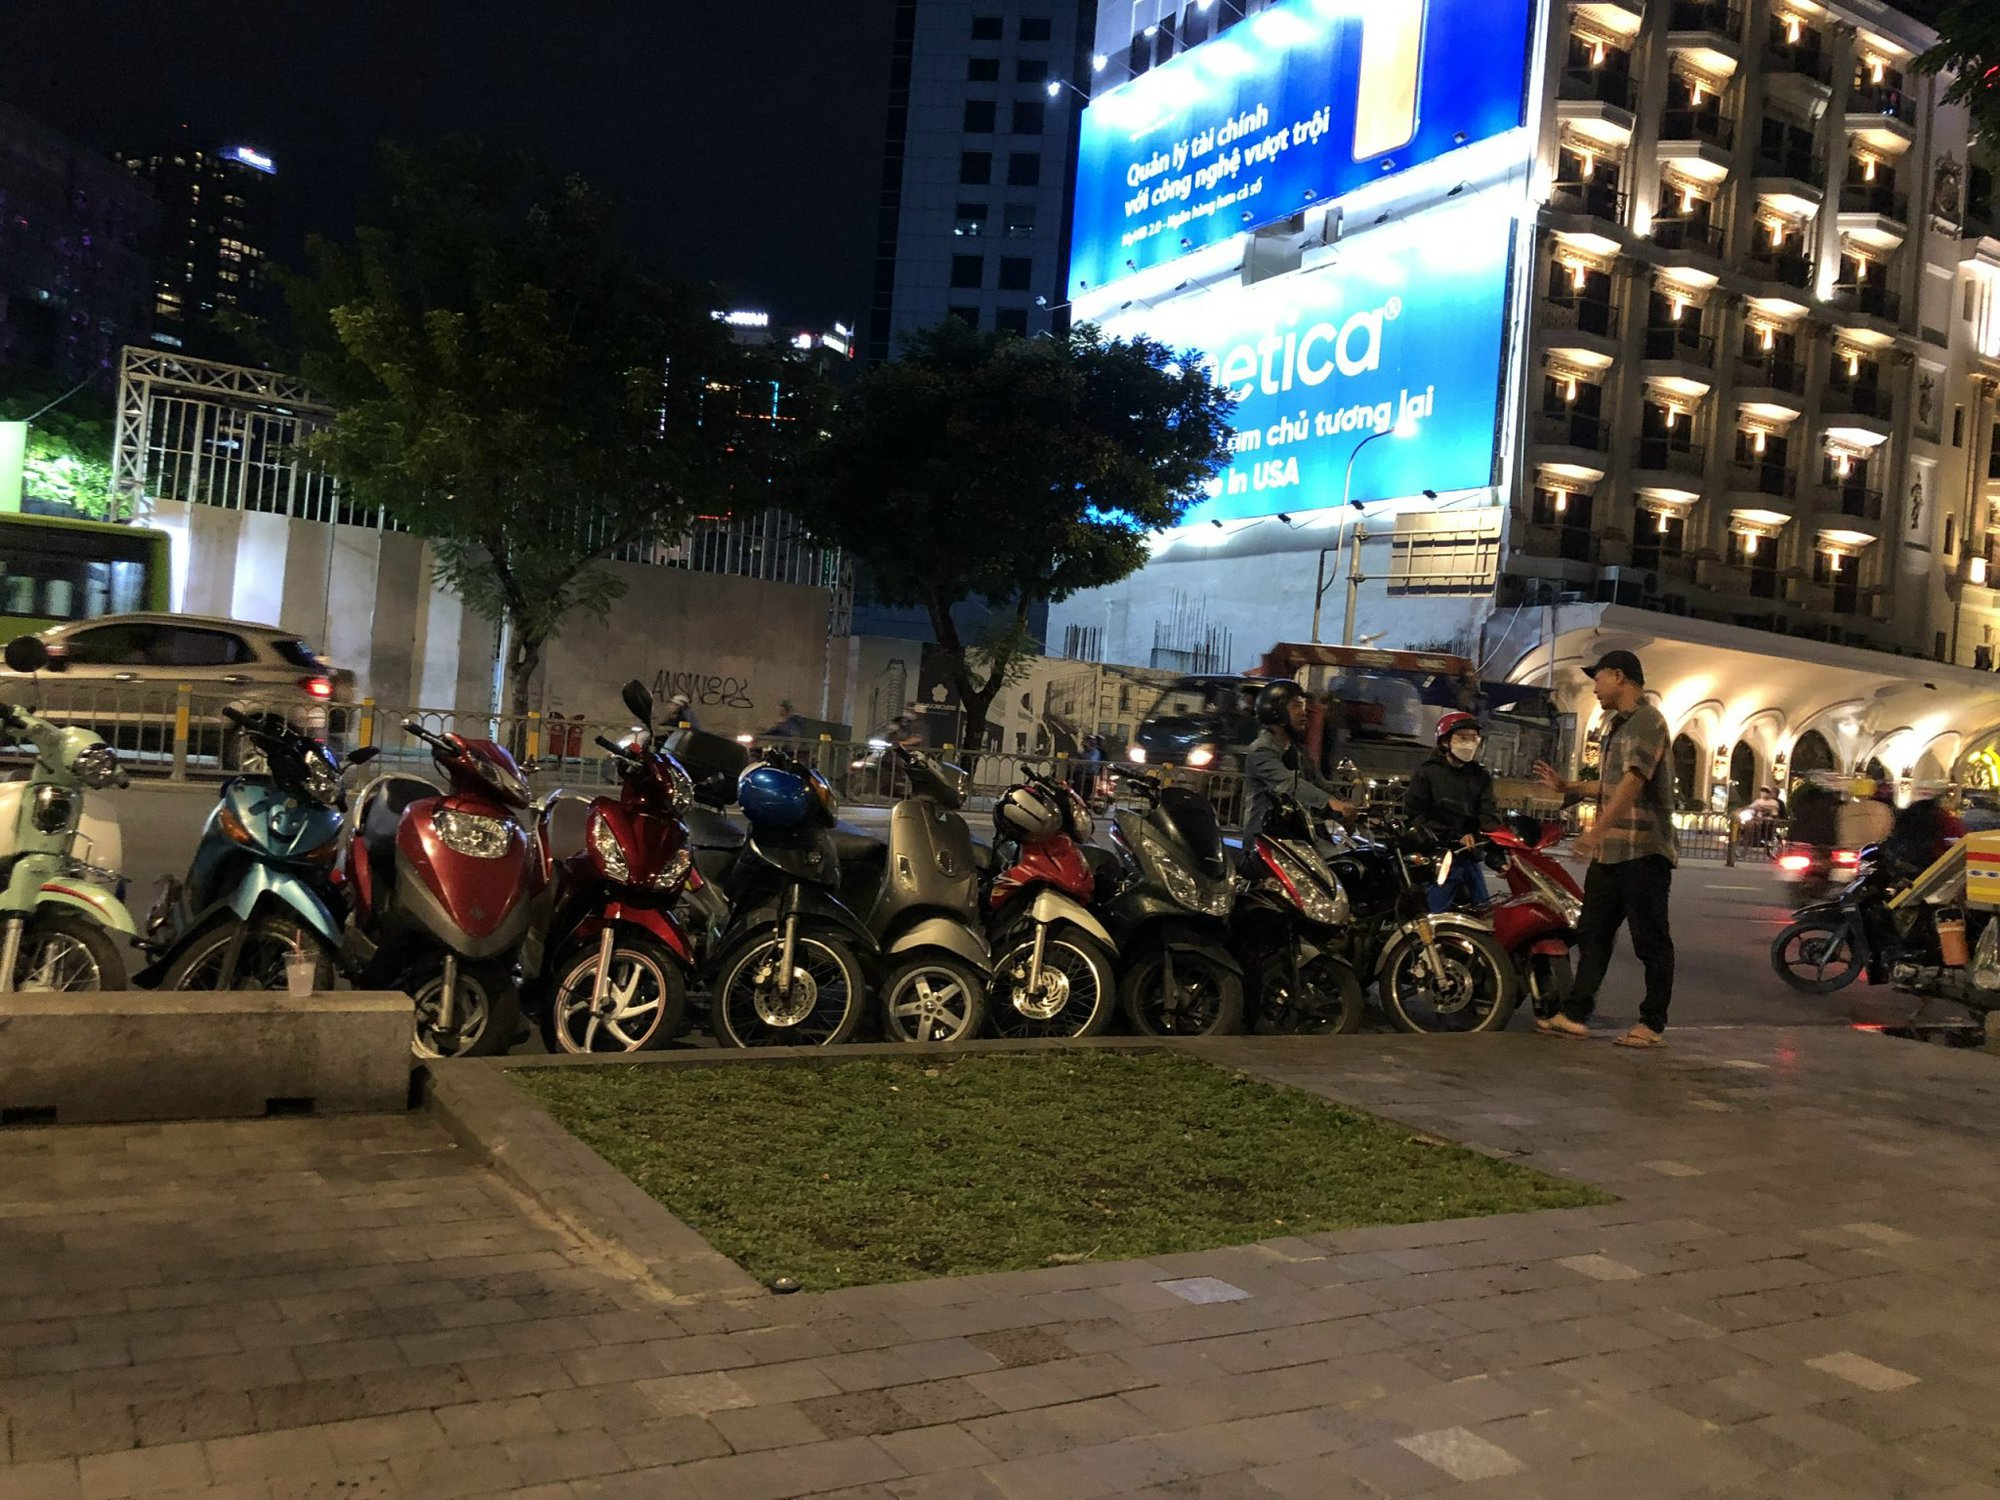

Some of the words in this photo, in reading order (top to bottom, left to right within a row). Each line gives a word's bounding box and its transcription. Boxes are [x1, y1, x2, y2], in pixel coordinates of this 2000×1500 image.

[1124, 186, 1149, 217] với
[1151, 173, 1192, 201] công
[1194, 147, 1241, 190] nghệ
[1244, 128, 1290, 166] vượt
[1292, 105, 1331, 145] trội
[1127, 151, 1170, 187] Quản
[1172, 139, 1189, 171] lý
[1191, 127, 1215, 159] tài
[1217, 102, 1269, 147] chính
[1266, 410, 1310, 446] chủ
[1315, 401, 1392, 437] tương
[1253, 456, 1300, 491] USA
